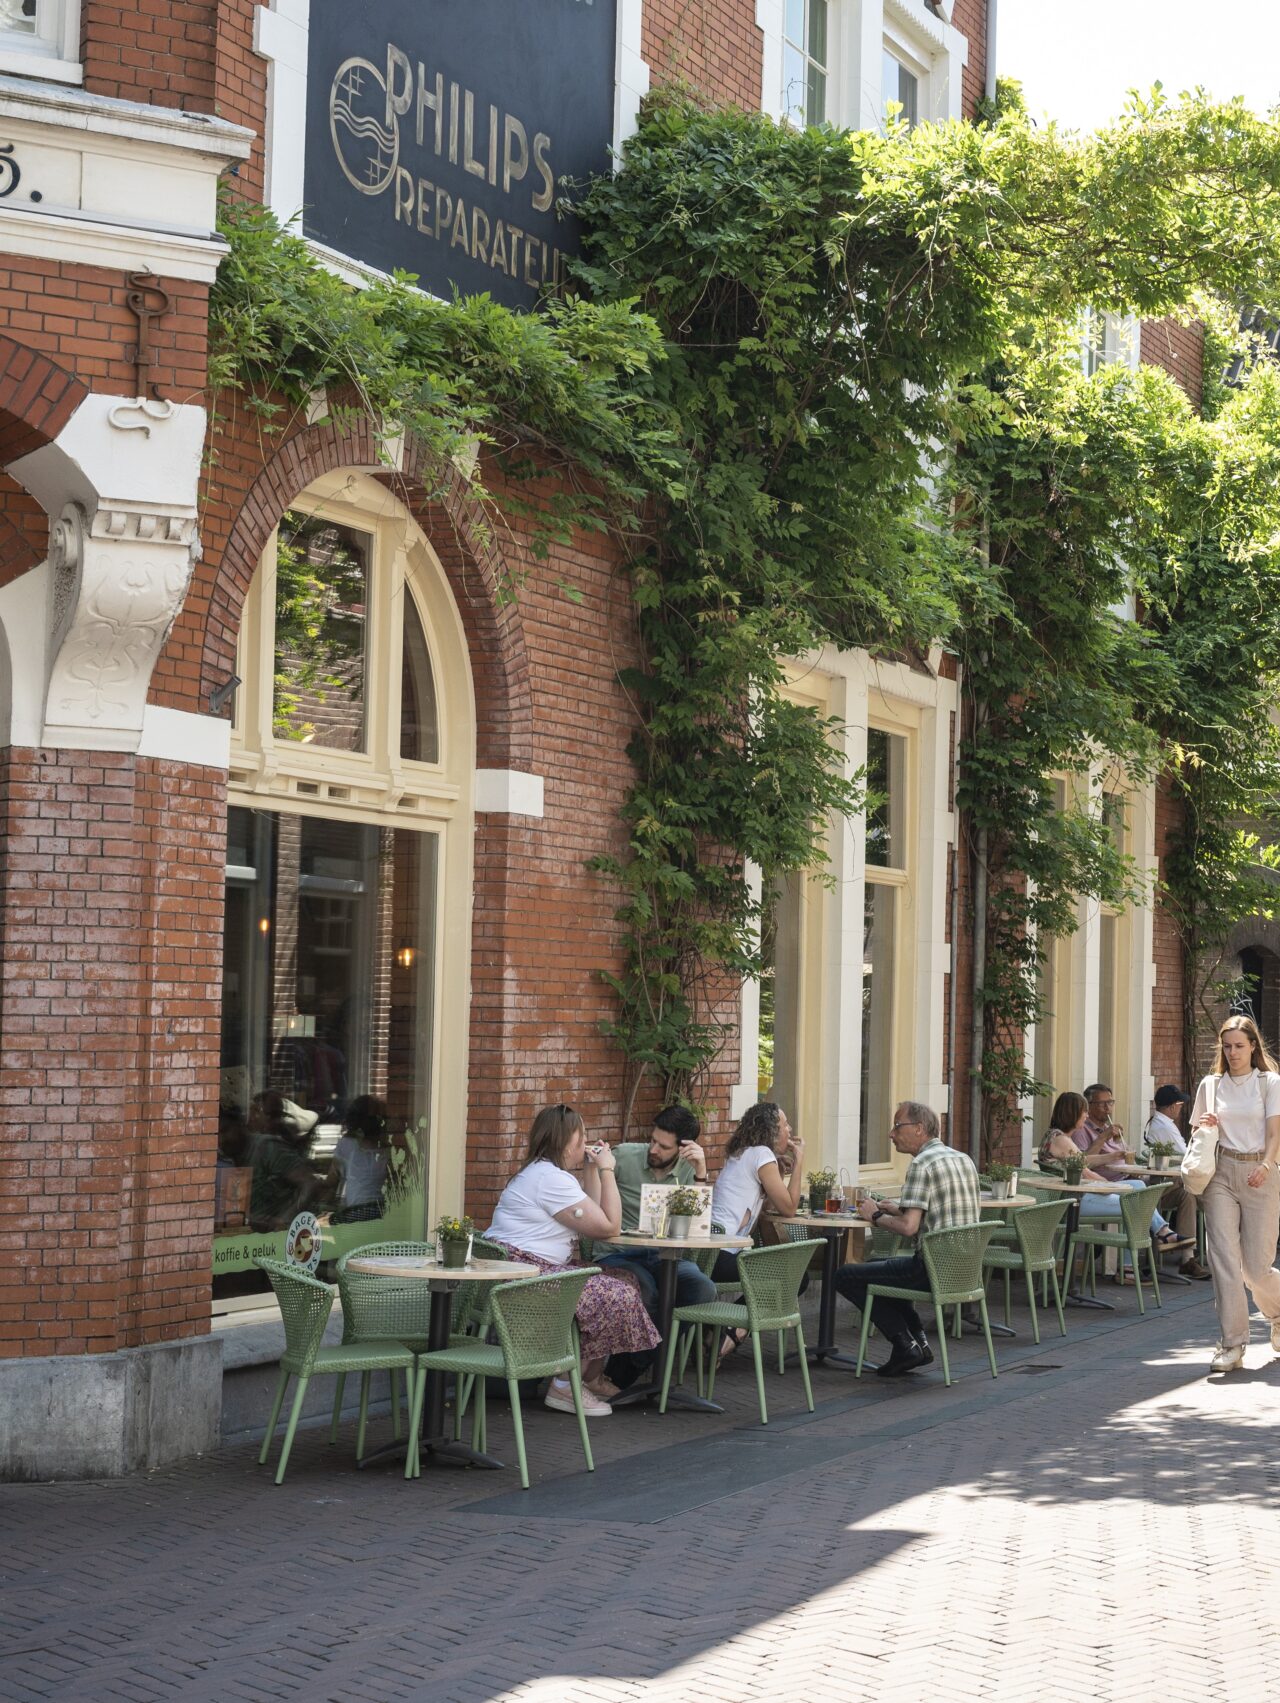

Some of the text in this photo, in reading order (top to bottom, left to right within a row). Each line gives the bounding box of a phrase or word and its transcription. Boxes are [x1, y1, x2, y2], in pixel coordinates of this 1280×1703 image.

[386, 43, 554, 212] PHILIPS
[291, 1215, 319, 1238] BAGELS
[215, 1247, 240, 1262] koffie
[242, 1245, 249, 1259] &
